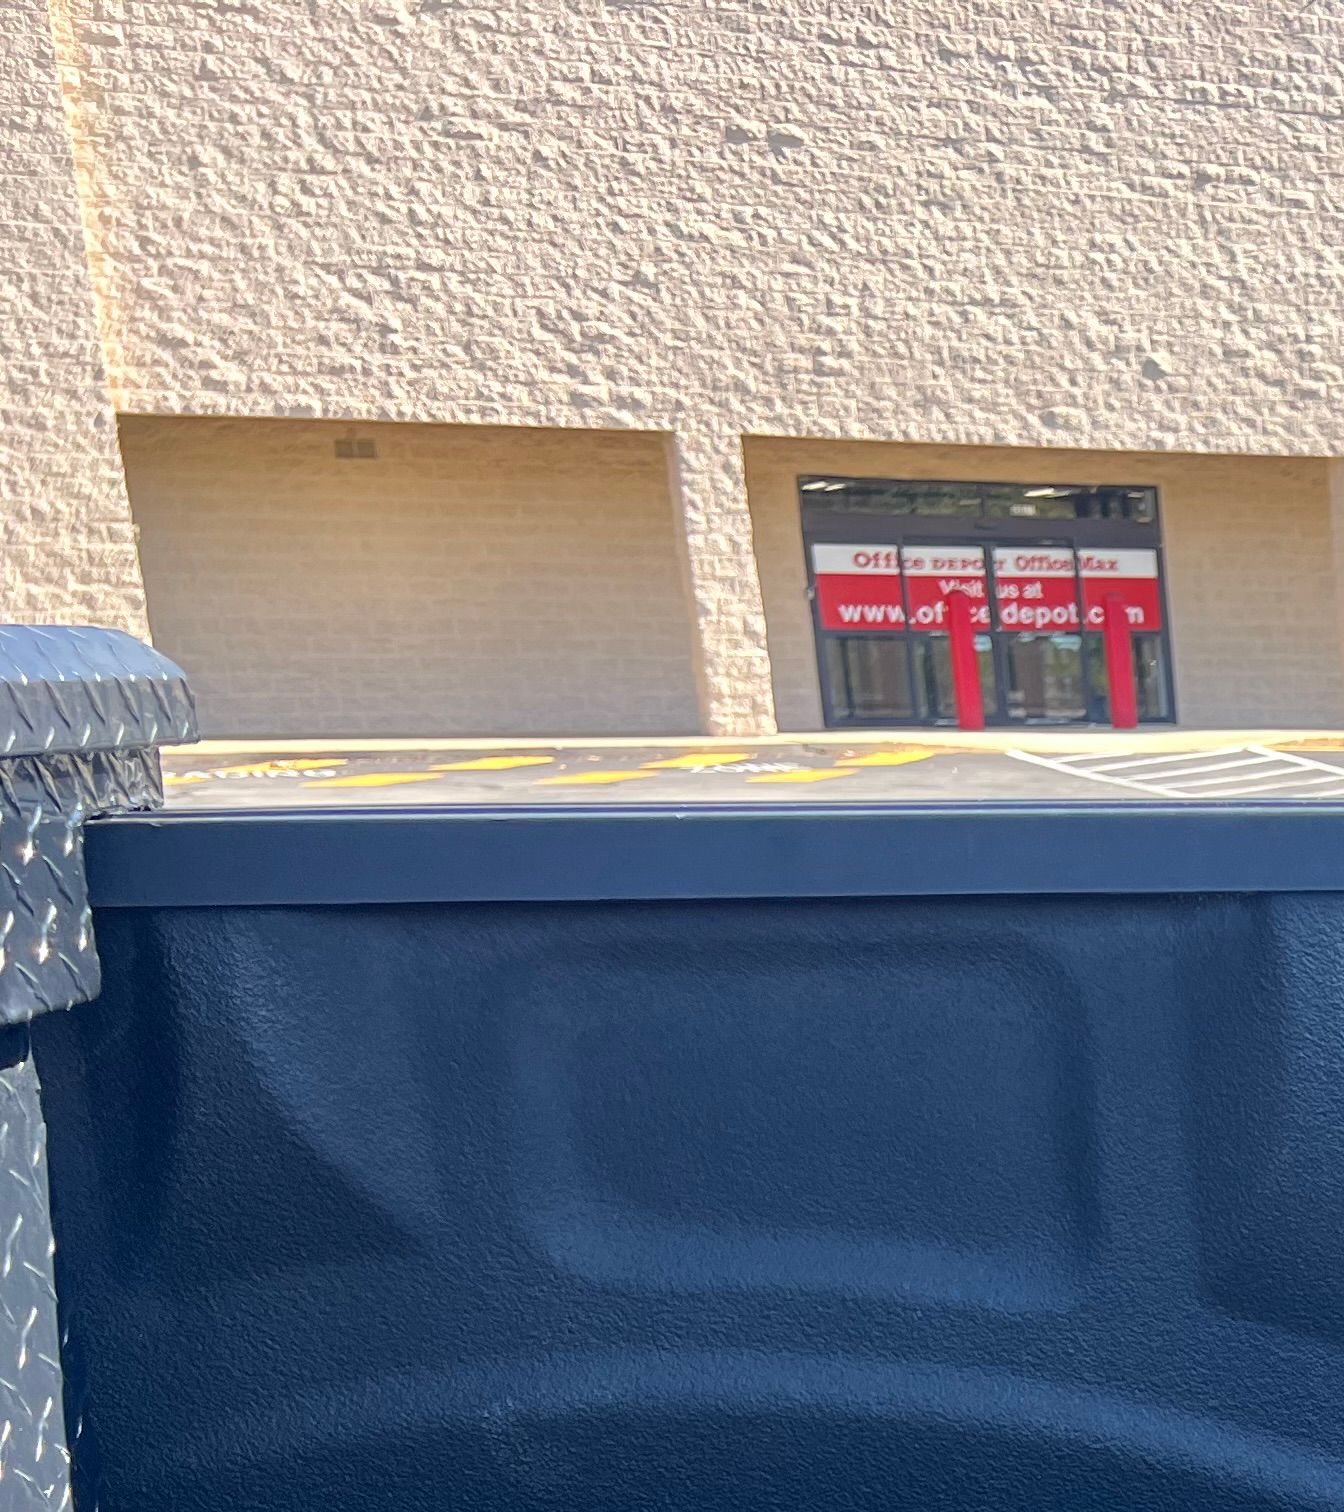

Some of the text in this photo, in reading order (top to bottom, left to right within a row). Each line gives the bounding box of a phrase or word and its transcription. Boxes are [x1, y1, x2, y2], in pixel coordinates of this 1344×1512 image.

[853, 551, 924, 570] Offce
[996, 584, 1019, 599] us
[1023, 581, 1043, 599] at
